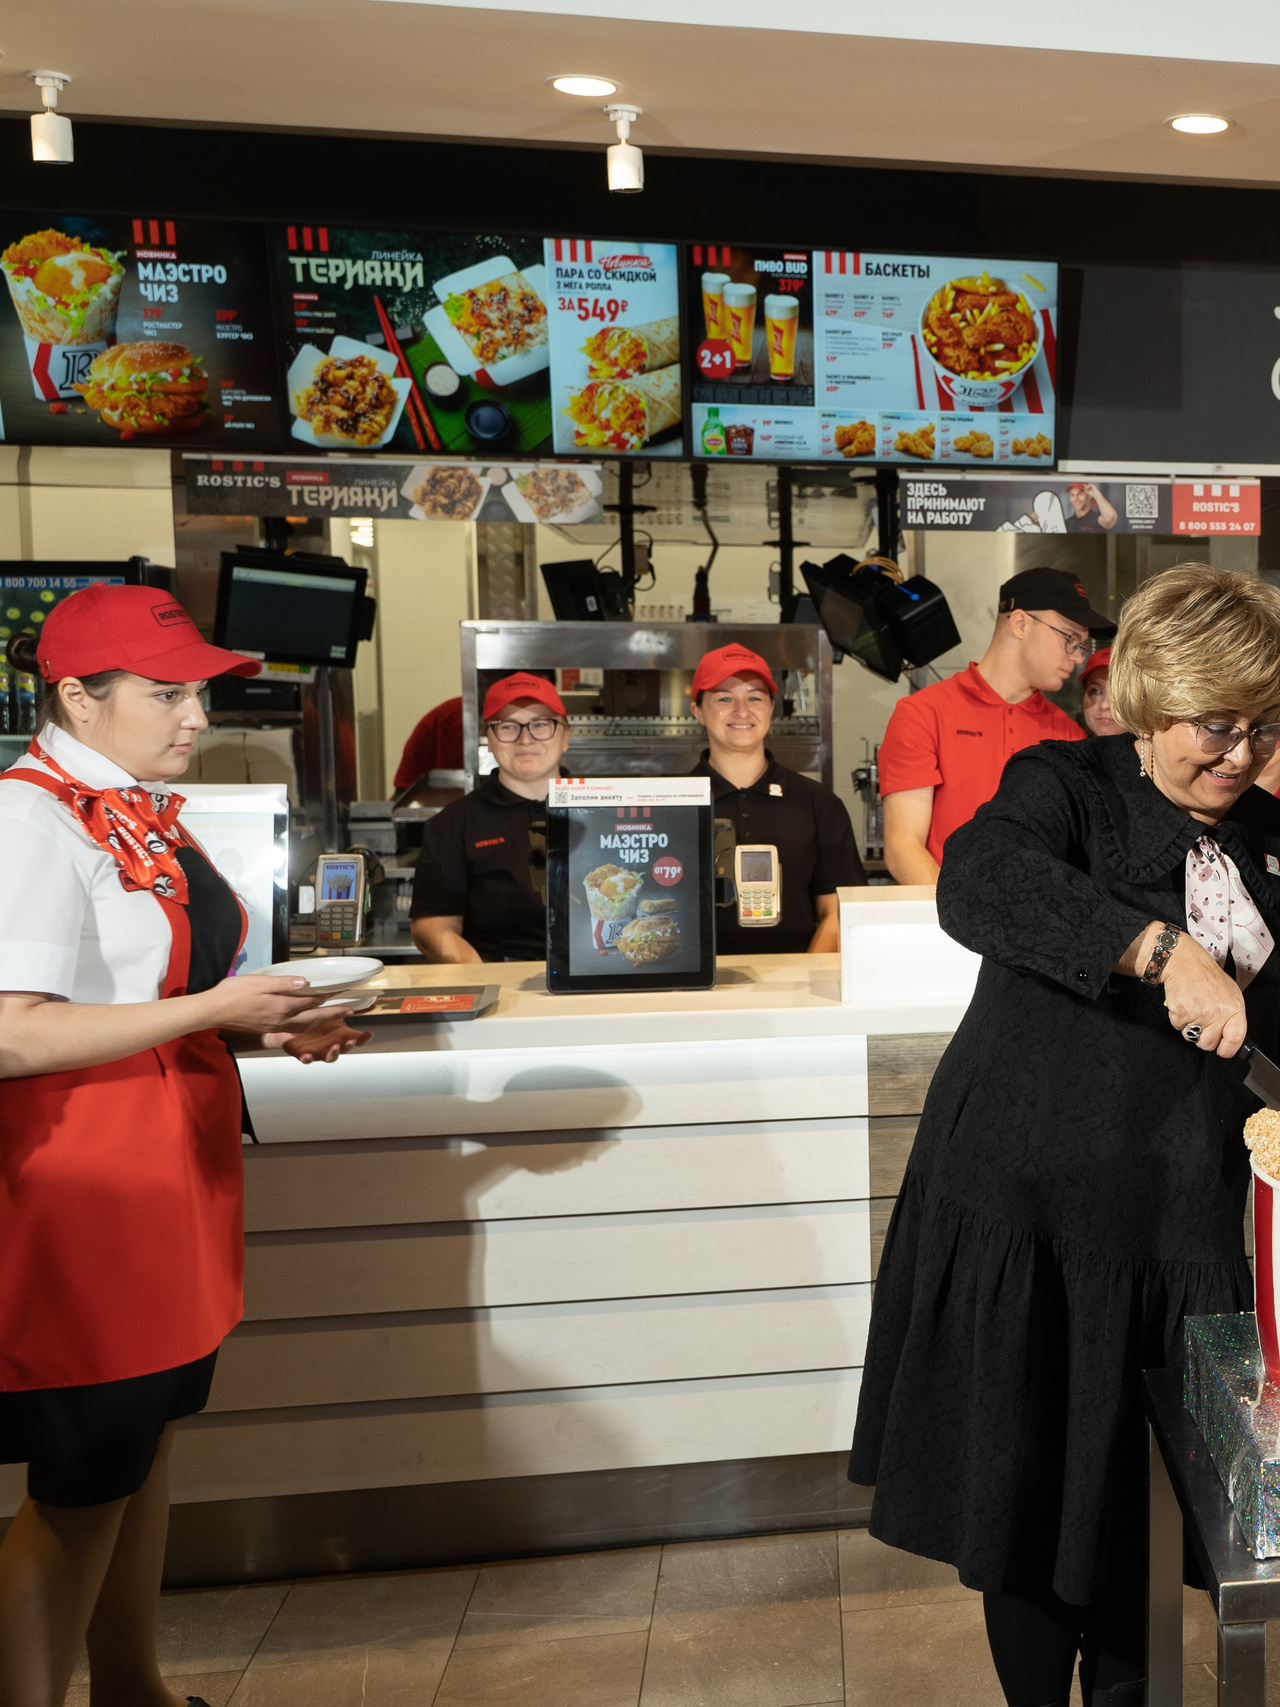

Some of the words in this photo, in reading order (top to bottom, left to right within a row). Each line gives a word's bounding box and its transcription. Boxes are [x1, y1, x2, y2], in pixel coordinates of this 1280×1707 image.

[137, 251, 177, 259] НОВИНКА
[371, 249, 424, 261] ЛИНЕЙКА
[137, 261, 227, 284] МАЭСТРО
[754, 260, 784, 273] ПИВО
[785, 261, 808, 274] BUD
[865, 262, 930, 279] БАСКЕТЫ
[288, 256, 425, 293] ТЕРИЯКИ
[556, 268, 584, 279] ПАРА
[587, 270, 601, 280] СО
[604, 268, 657, 283] СКИДКОЙ
[139, 283, 179, 303] ЧИЗ
[563, 282, 583, 290] МЕГА
[585, 282, 612, 291] РОЛЛА
[558, 297, 575, 311] ЗА
[577, 298, 628, 322] 549₽
[700, 349, 732, 368] 2+1
[196, 474, 281, 488] ROSTIC'S
[354, 478, 397, 487] ЛИНЕЙКА
[906, 482, 948, 498] ЗДЕСЬ
[286, 485, 398, 512] ТЕРИЯКИ
[906, 497, 987, 511] ПРИНИМАЮТ
[1192, 502, 1240, 513] ROSTIC'S
[907, 512, 925, 525] НА
[926, 512, 974, 526] РАБОТУ
[1179, 521, 1186, 531] 8
[1188, 521, 1207, 531] 800
[1209, 521, 1227, 531] 555
[1229, 521, 1242, 531] 24
[1243, 522, 1256, 531] 07
[5, 577, 25, 588] 800
[28, 577, 46, 588] 700
[49, 577, 60, 588] 14
[63, 577, 77, 588] 55
[600, 794, 623, 802] анкету
[117, 826, 155, 867] ROSTIC'S
[600, 834, 669, 849] МАЭСТРО
[619, 849, 650, 864] ЧИЗ
[654, 867, 664, 875] ОТ
